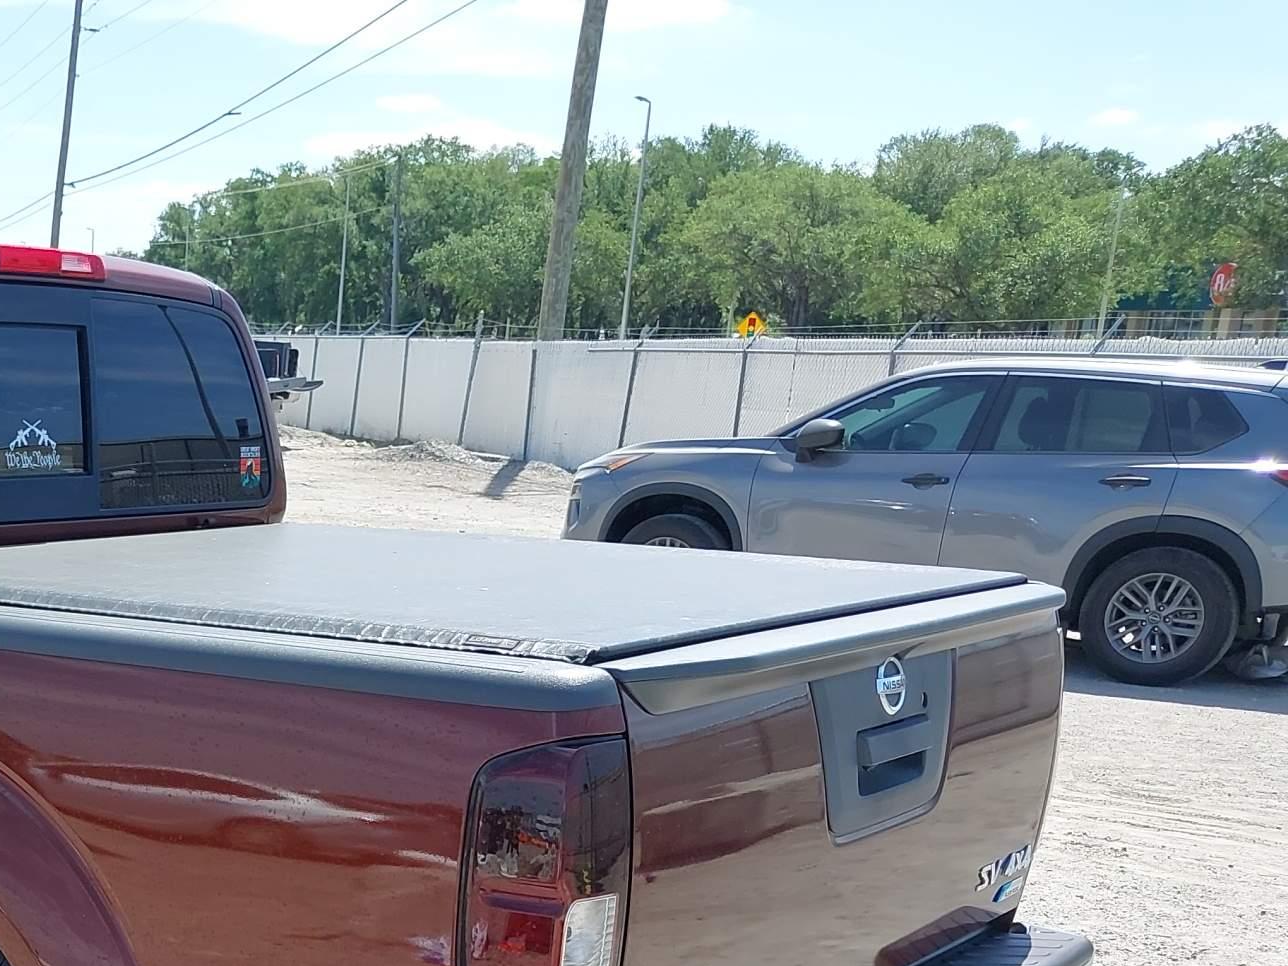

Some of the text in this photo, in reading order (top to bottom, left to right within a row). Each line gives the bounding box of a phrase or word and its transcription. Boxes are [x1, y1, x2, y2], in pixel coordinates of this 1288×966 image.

[5, 450, 21, 469] We
[32, 450, 61, 470] People
[975, 859, 1002, 892] SV
